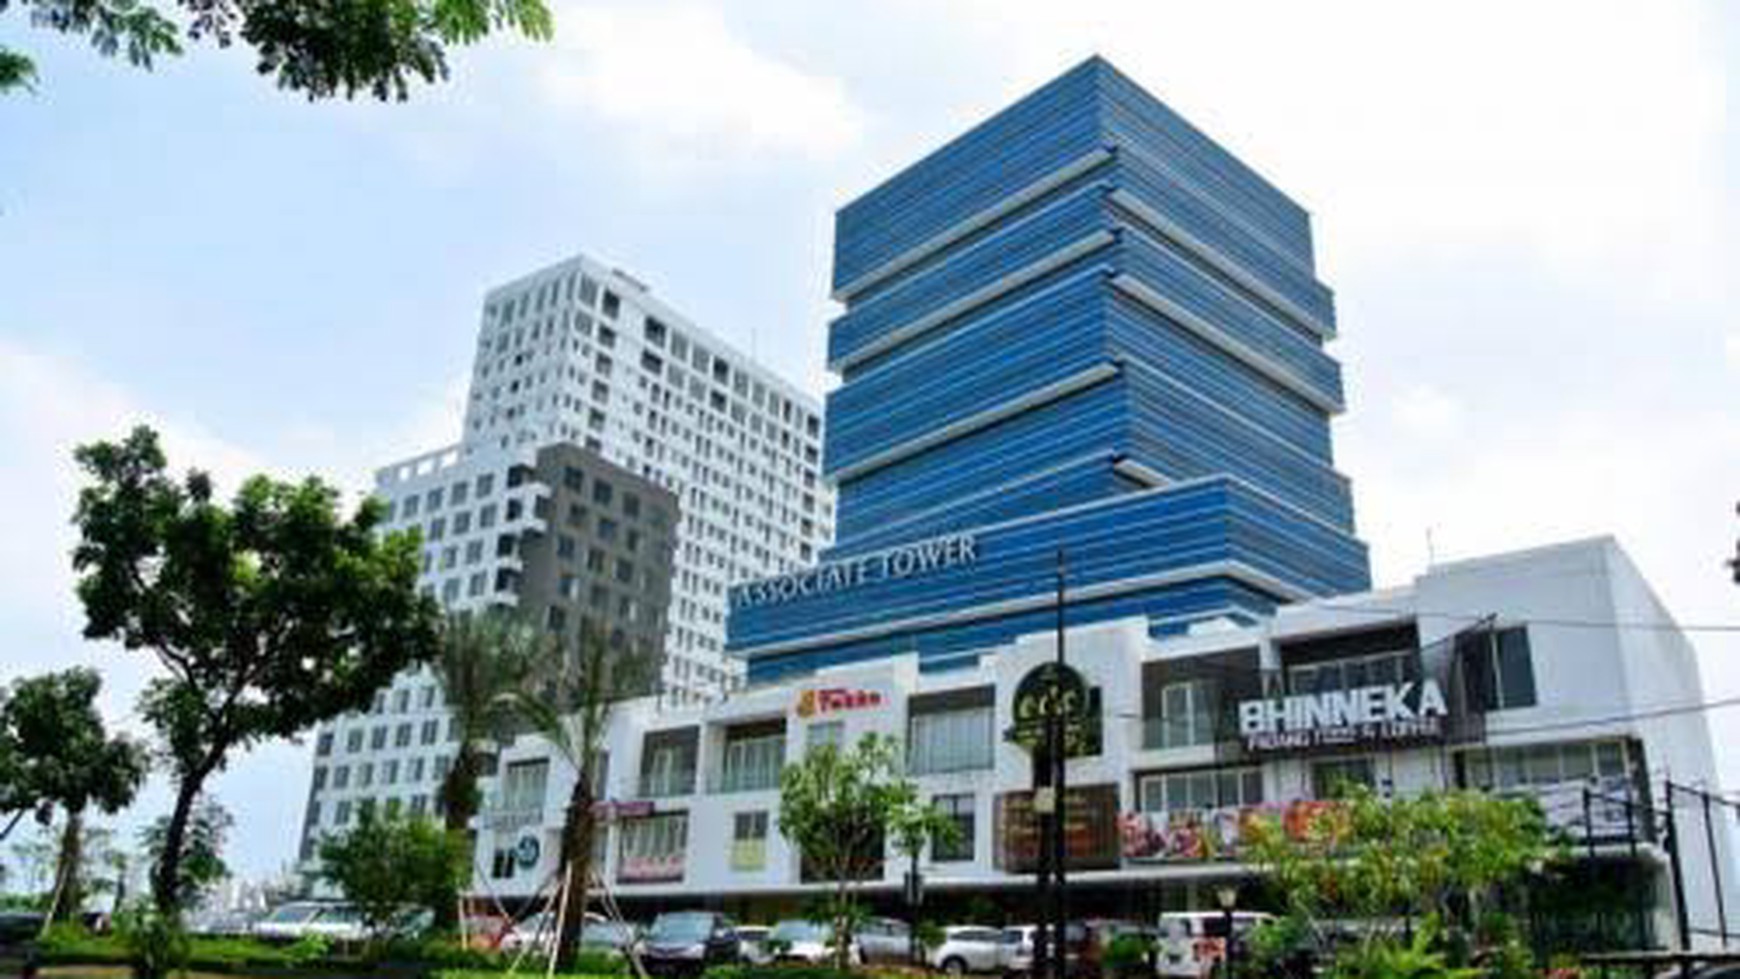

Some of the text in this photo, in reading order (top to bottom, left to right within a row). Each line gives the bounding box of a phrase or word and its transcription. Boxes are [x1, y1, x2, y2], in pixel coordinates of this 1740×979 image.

[736, 535, 976, 607] ASSOCIATE TOWER
[1239, 679, 1448, 734] BHINNEKA
